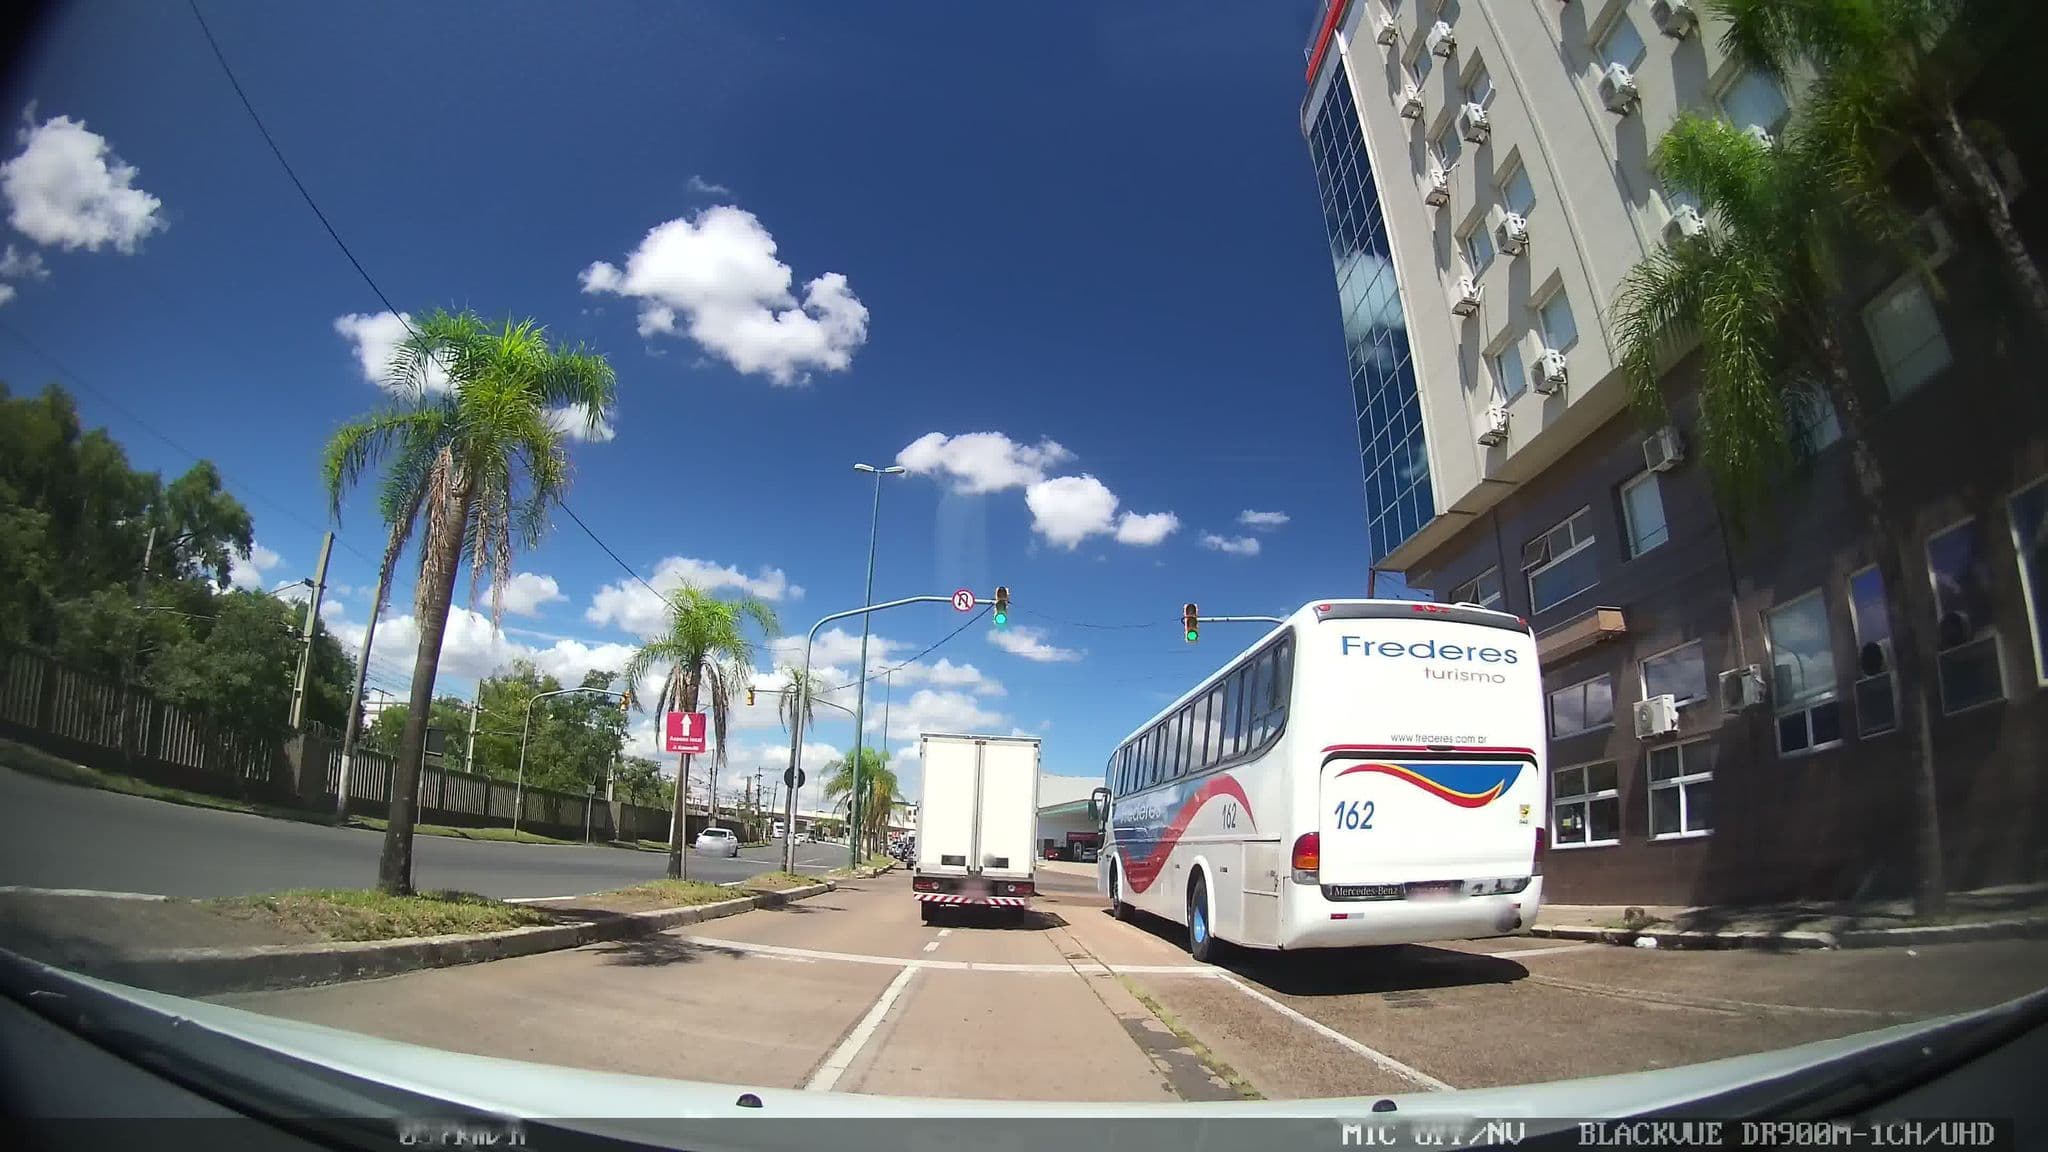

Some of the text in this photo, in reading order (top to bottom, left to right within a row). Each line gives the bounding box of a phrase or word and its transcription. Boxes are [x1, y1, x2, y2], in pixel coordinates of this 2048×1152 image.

[1341, 635, 1518, 664] Frederes
[1424, 666, 1506, 684] turismo
[1222, 803, 1237, 830] 162
[1334, 800, 1375, 830] 162
[1334, 885, 1399, 897] Mercedes-Benz
